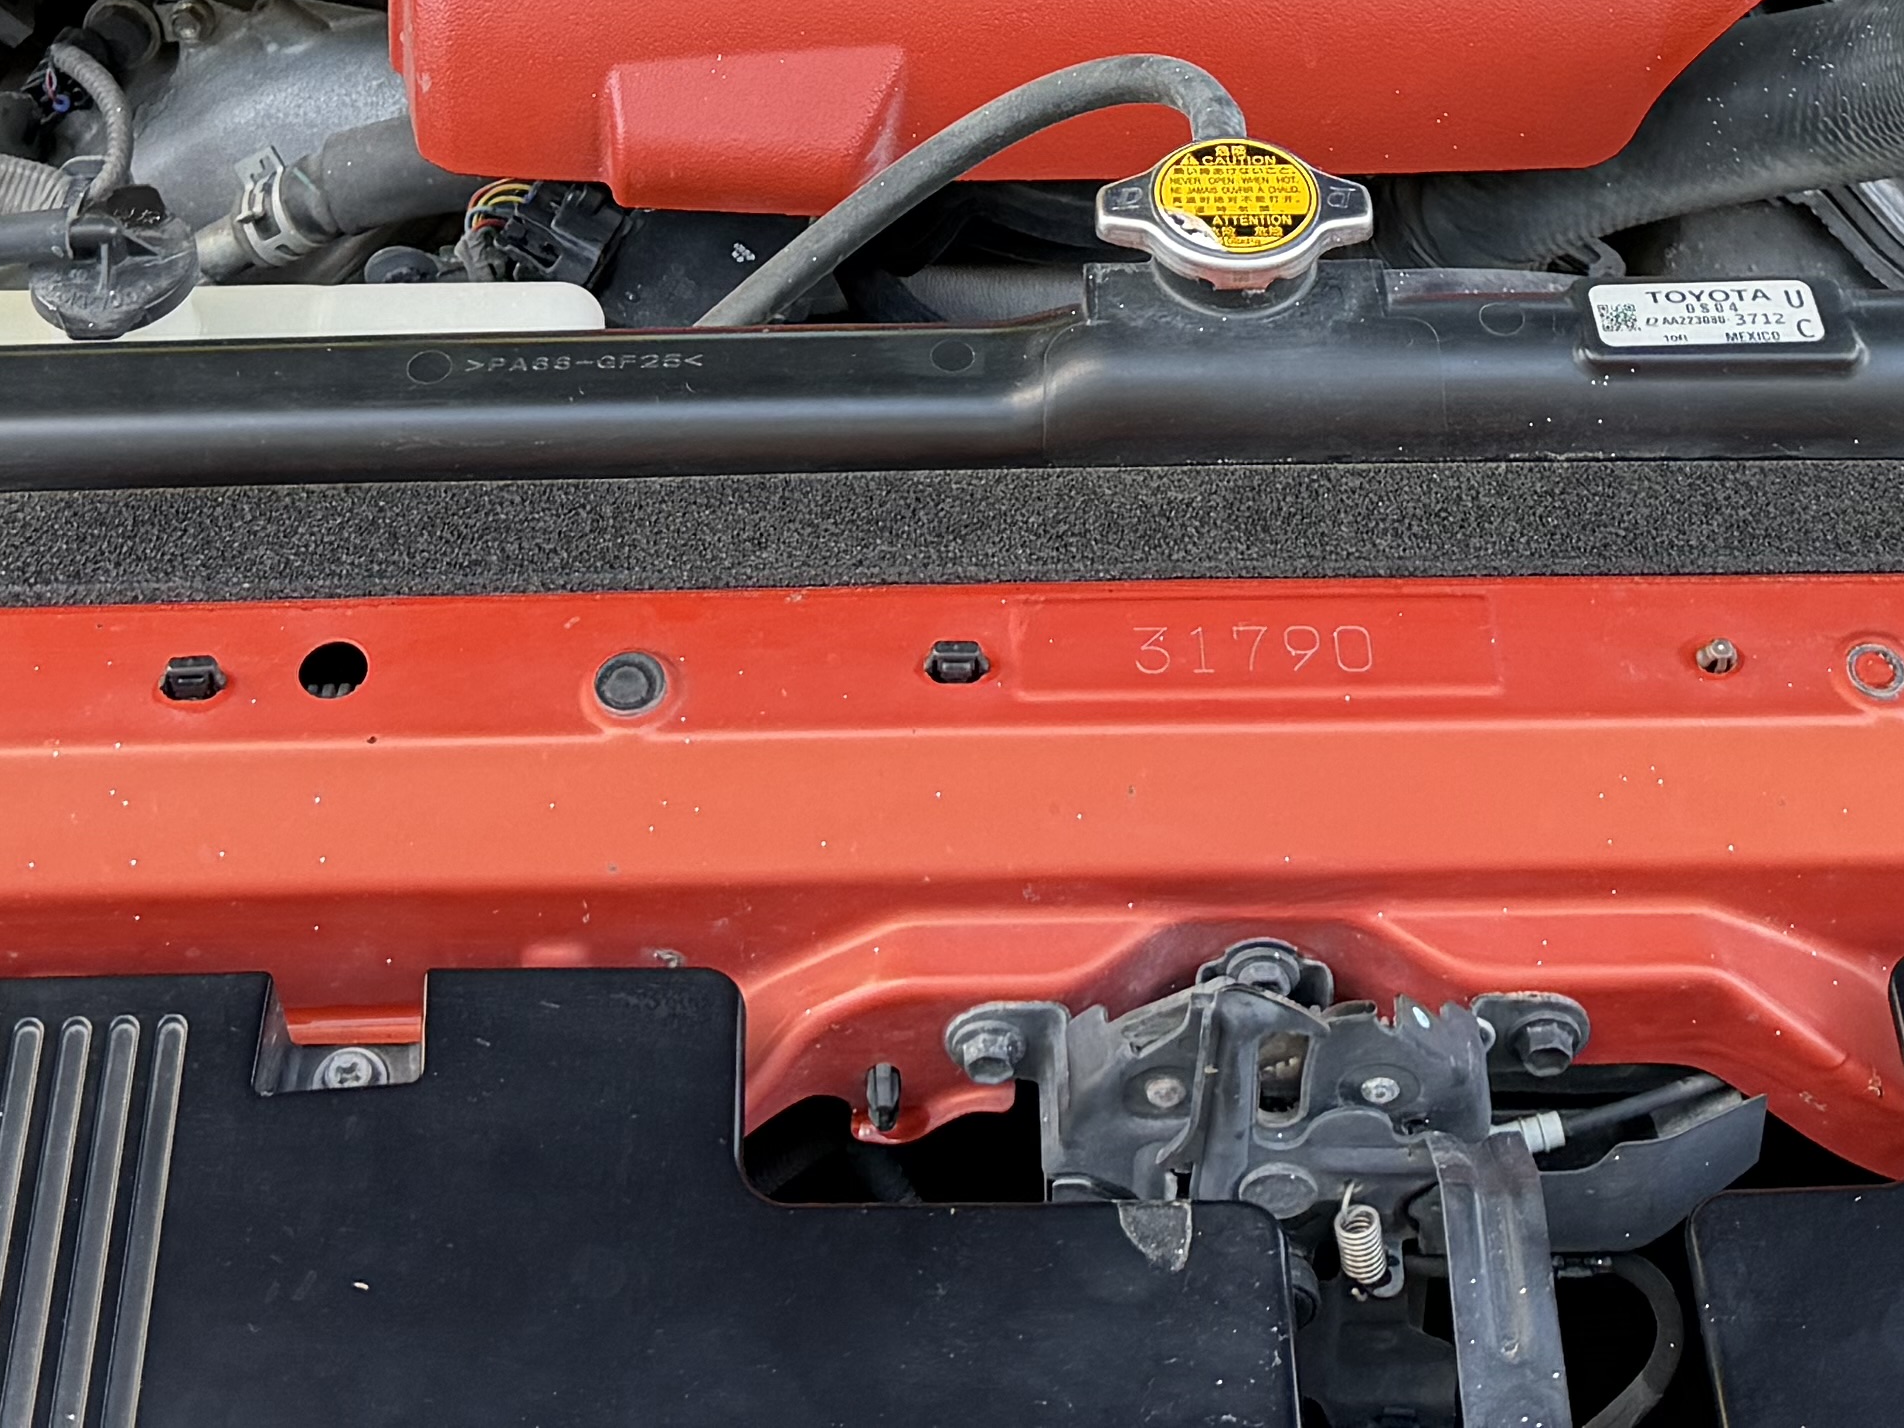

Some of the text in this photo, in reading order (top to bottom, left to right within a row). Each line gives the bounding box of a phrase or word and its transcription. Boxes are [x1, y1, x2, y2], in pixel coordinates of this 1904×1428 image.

[1201, 155, 1277, 166] CAUTION
[1169, 177, 1202, 186] NEVER
[1207, 177, 1235, 186] OPEN
[1241, 177, 1270, 186] WHEN
[1212, 214, 1292, 226] ATTENTION
[1645, 288, 1772, 304] TOYOTA
[1734, 312, 1787, 326] 3712
[1796, 318, 1816, 338] C
[1724, 330, 1781, 343] MEXICO
[1132, 624, 1374, 675] 31790
